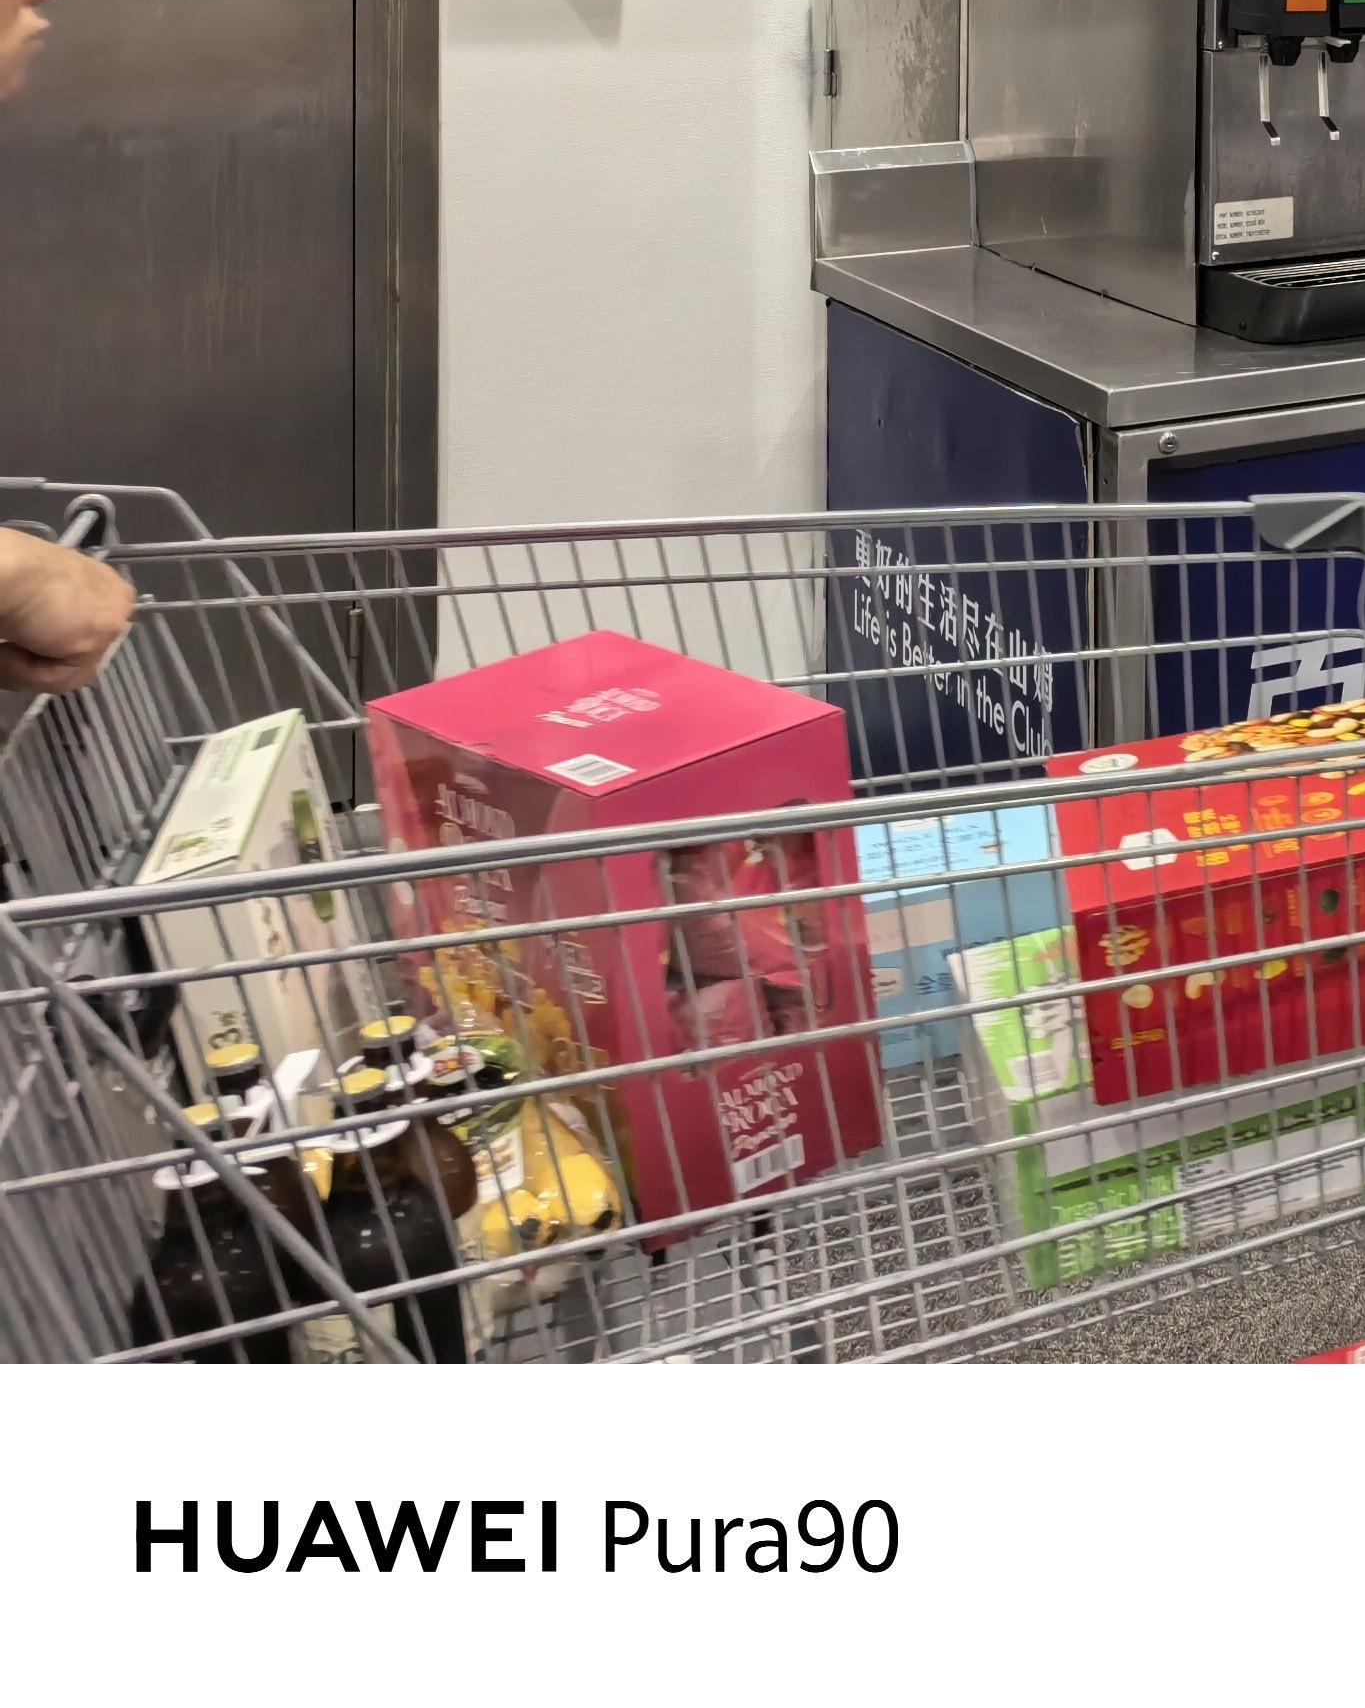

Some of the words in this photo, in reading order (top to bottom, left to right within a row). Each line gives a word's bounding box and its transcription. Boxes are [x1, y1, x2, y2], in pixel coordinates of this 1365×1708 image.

[855, 529, 1053, 712] 更好的生活尽在山姆
[855, 589, 880, 645] Life
[886, 611, 896, 657] is
[977, 675, 1004, 734] the
[1012, 700, 1052, 757] Club
